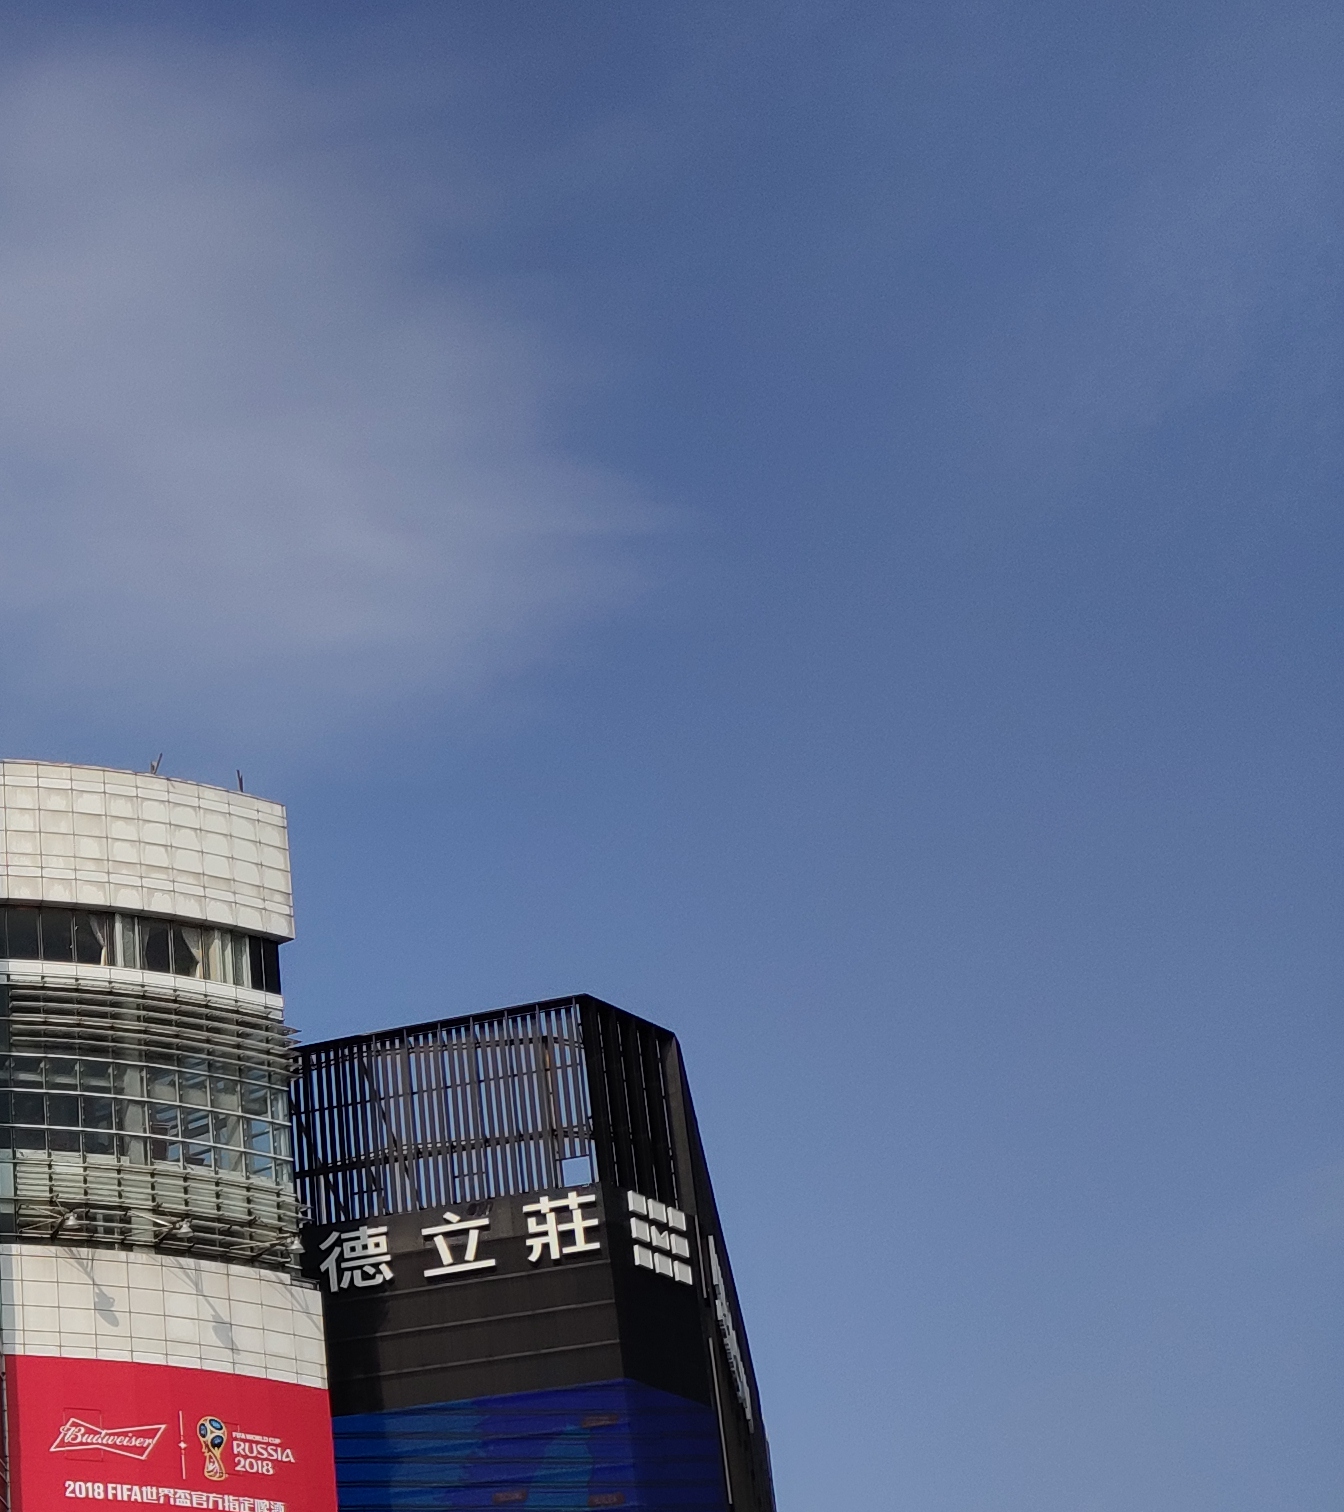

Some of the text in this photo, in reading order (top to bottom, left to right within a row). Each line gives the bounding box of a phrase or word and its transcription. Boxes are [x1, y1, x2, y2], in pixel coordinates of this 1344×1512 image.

[318, 1191, 602, 1294] 德立莊
[60, 1425, 154, 1448] Budweiser
[232, 1440, 296, 1463] RUSSIA
[234, 1456, 274, 1475] 2018
[64, 1480, 105, 1500] 2018
